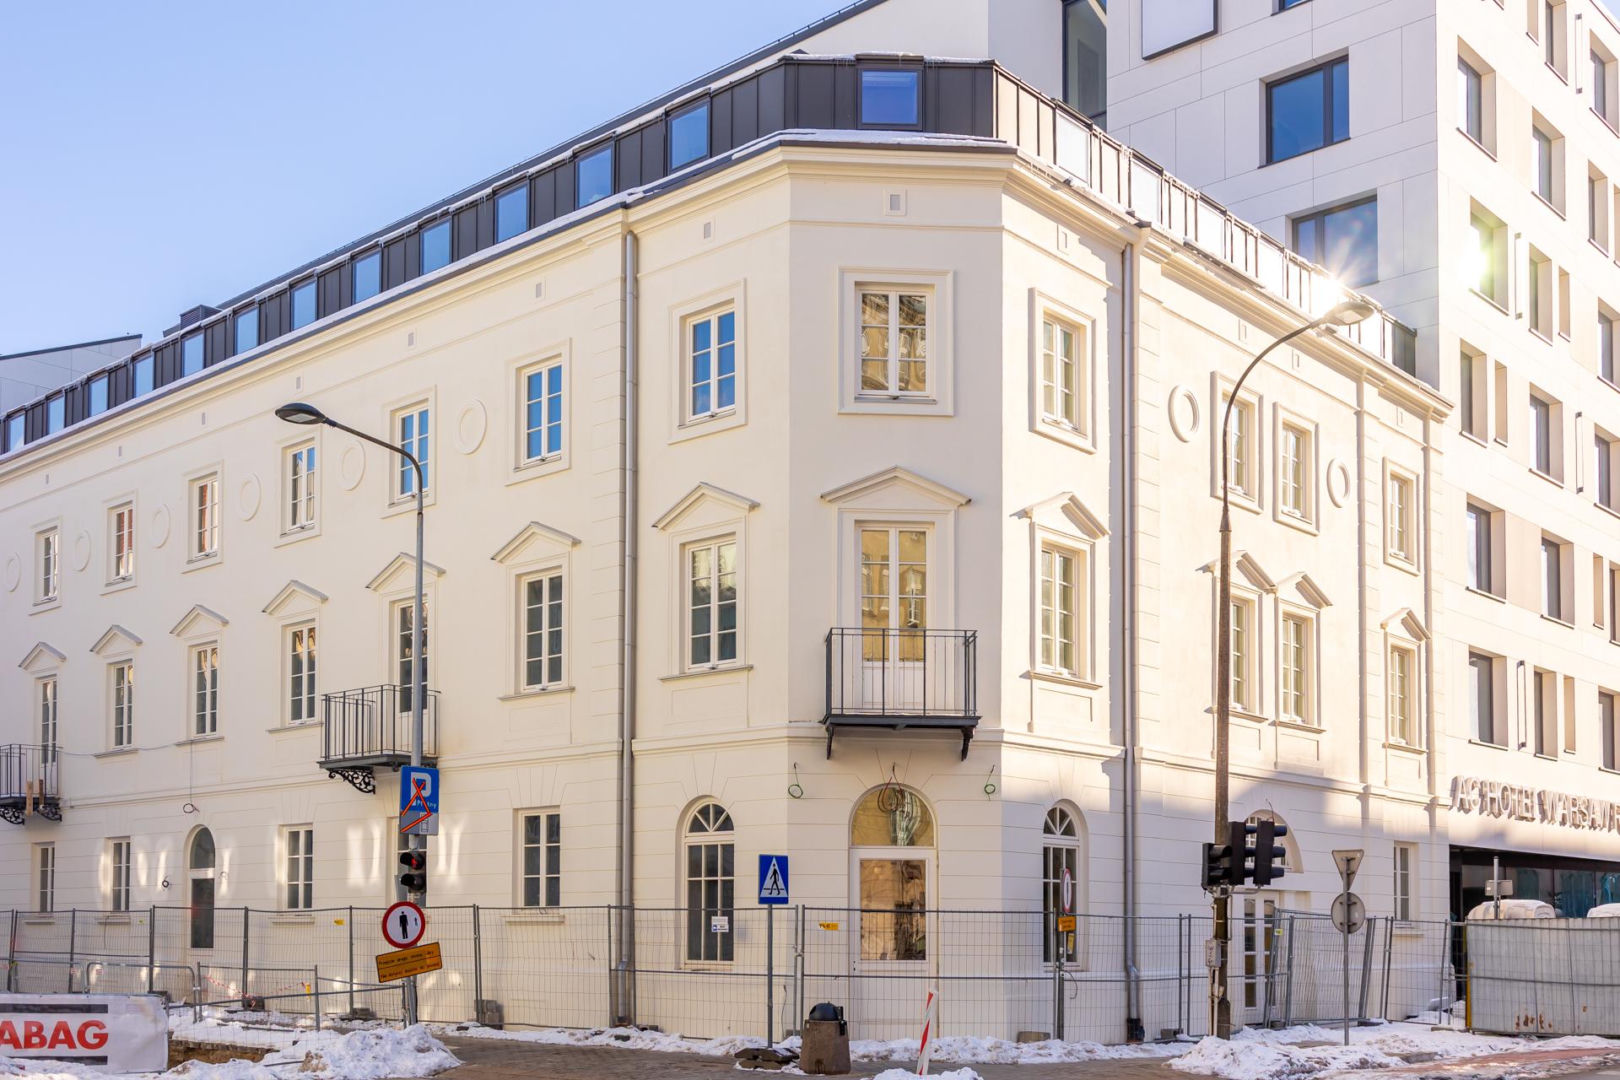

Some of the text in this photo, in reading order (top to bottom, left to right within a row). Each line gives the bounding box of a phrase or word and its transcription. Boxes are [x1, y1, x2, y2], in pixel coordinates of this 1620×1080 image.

[411, 772, 432, 806] P
[1451, 775, 1481, 812] AC
[1482, 780, 1536, 820] HOTEL
[0, 1020, 109, 1050] ABAG
